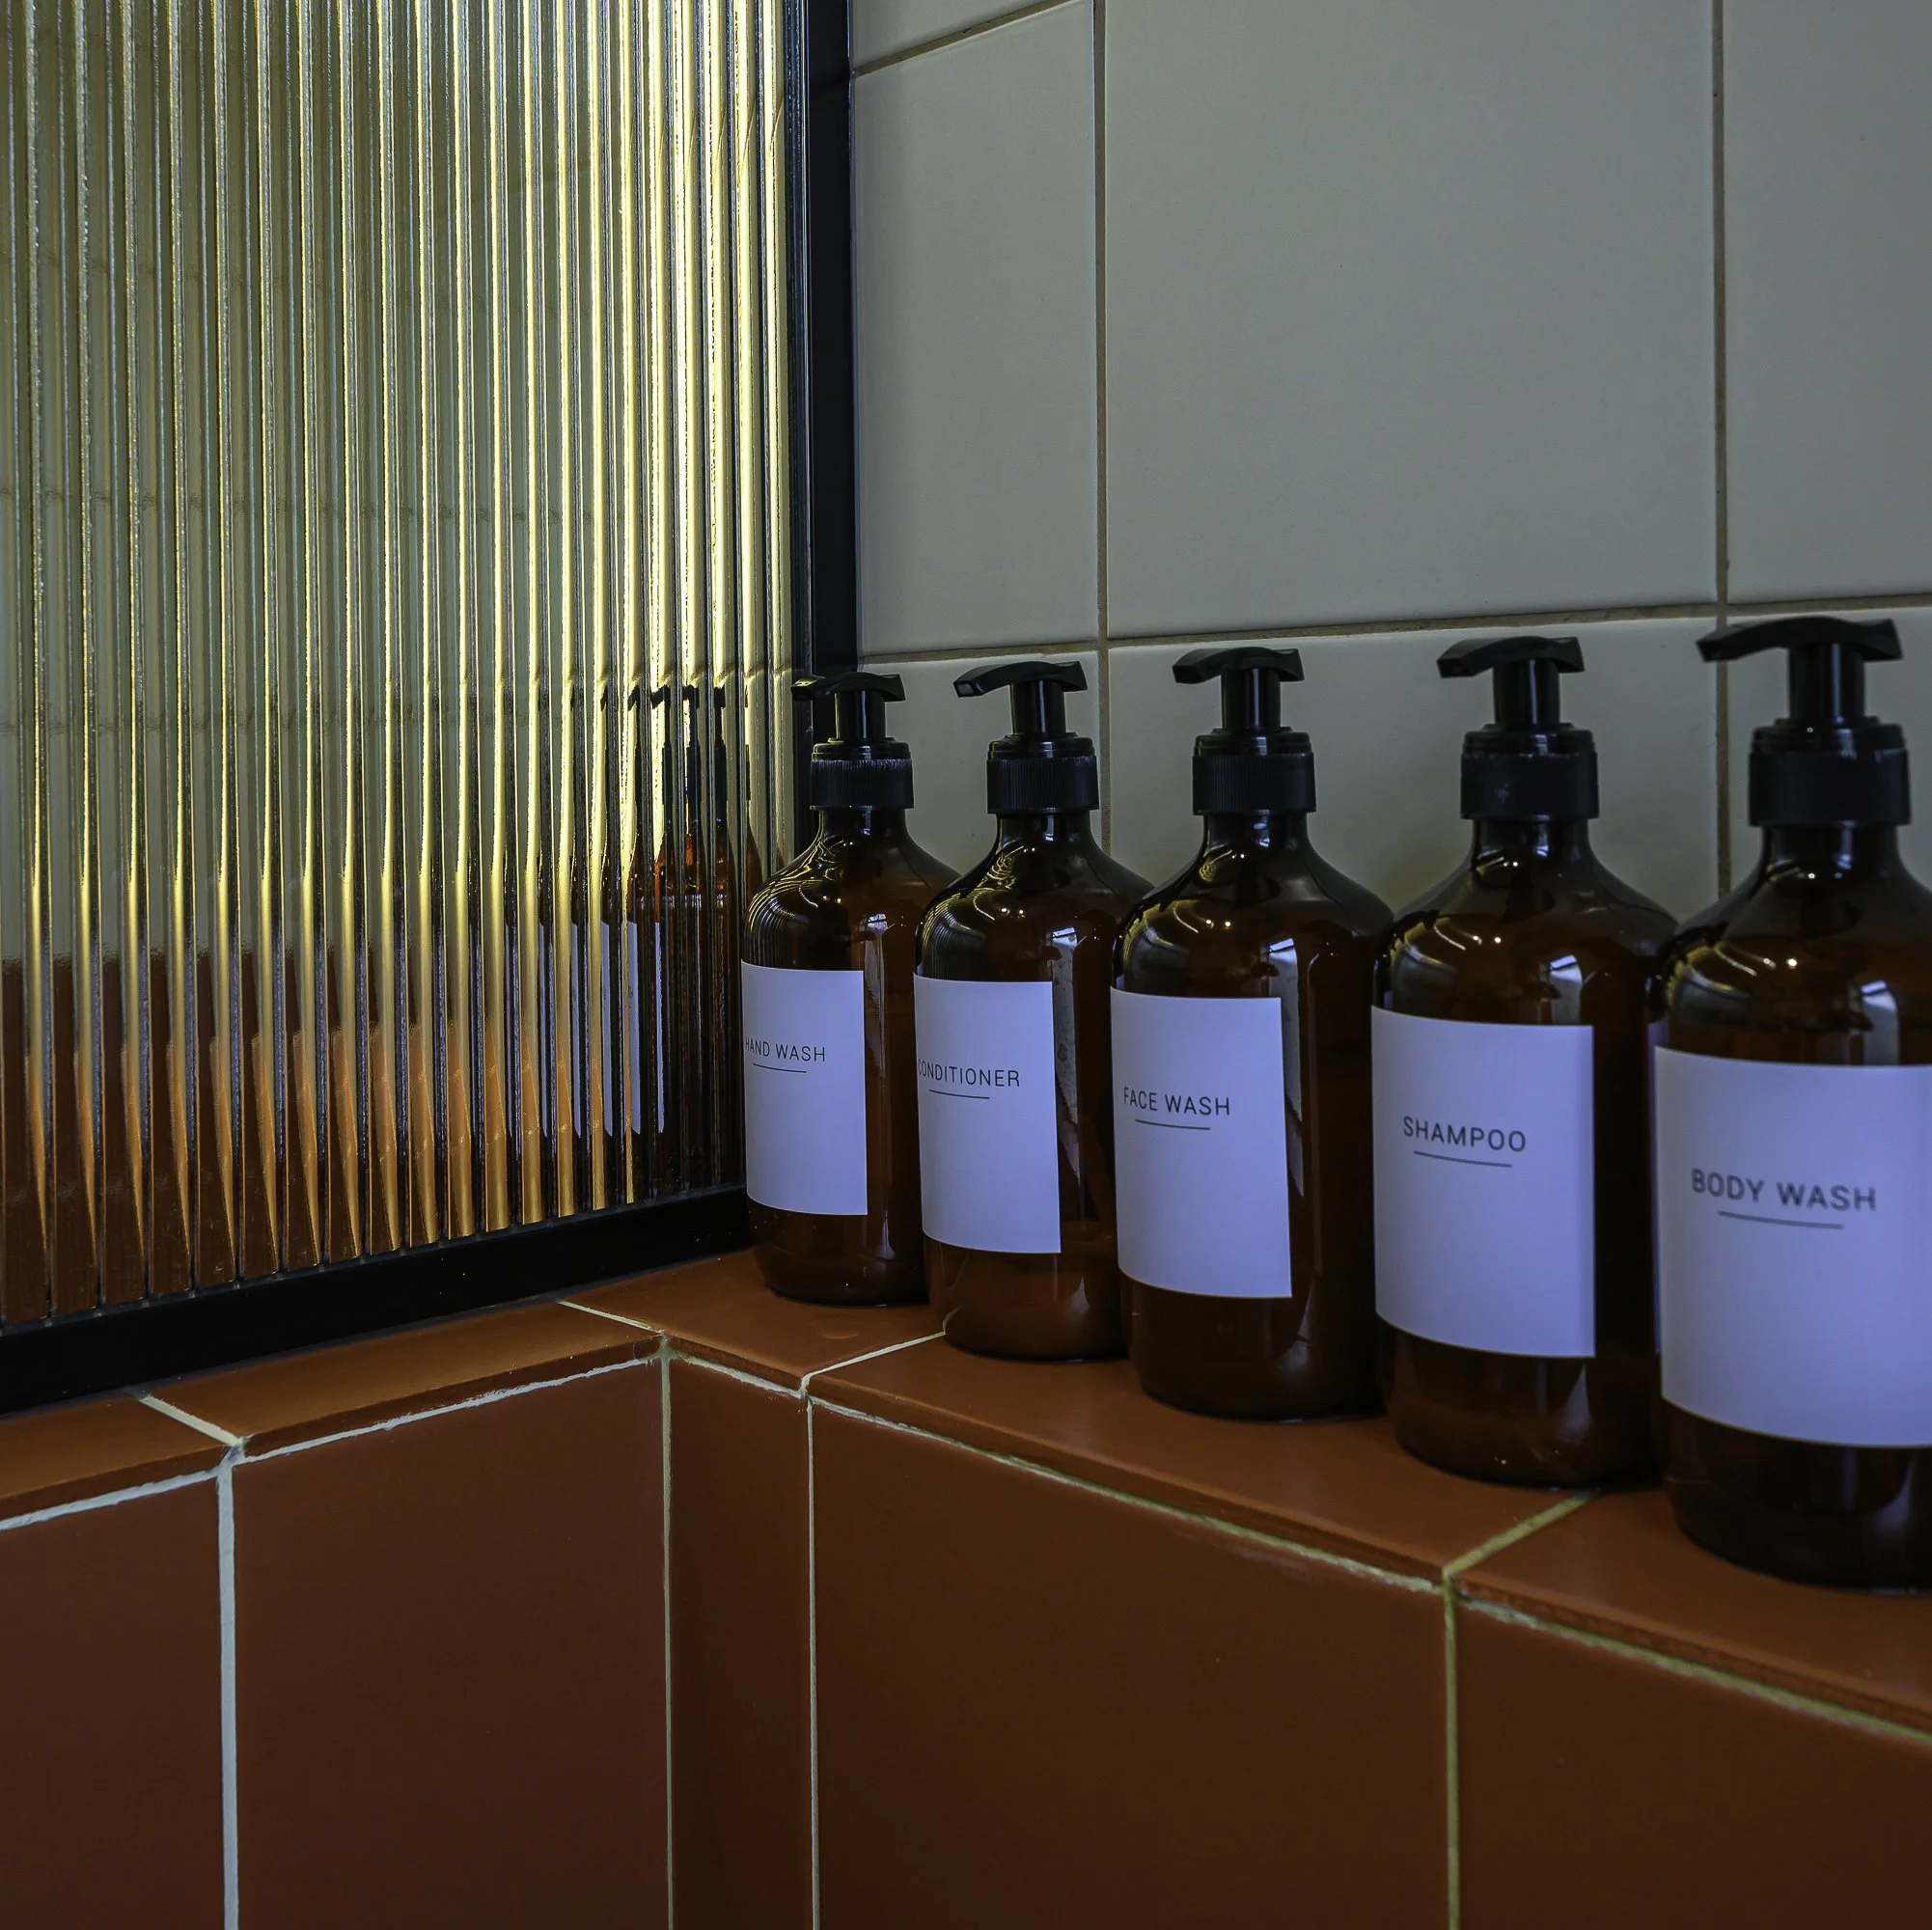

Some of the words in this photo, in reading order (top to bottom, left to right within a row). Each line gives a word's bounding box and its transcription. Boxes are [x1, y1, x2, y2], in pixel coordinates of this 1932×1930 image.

[745, 1035, 770, 1058] HAND
[775, 1043, 826, 1062] WASH
[1123, 1087, 1158, 1112] FACE
[1164, 1093, 1230, 1116] WASH
[1403, 1116, 1527, 1152] SHAMPOO
[1691, 1168, 1765, 1202] BODY
[1776, 1181, 1877, 1211] WASH
